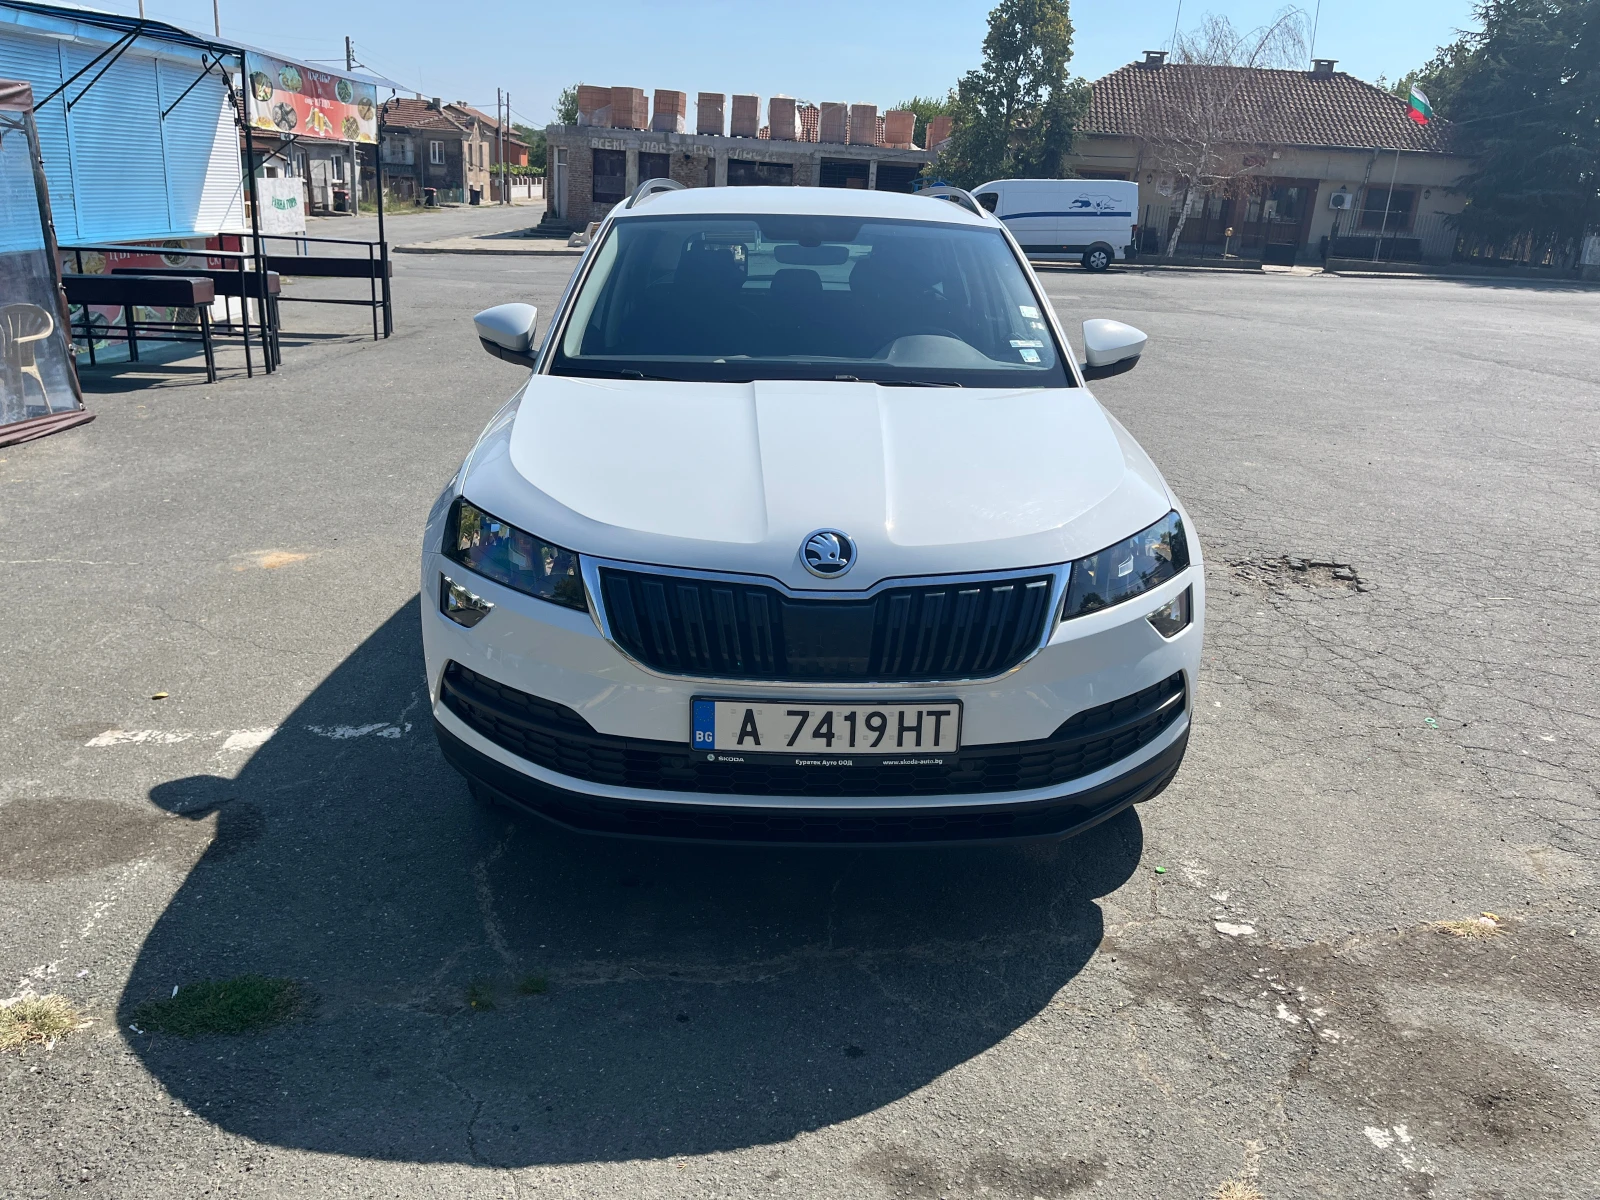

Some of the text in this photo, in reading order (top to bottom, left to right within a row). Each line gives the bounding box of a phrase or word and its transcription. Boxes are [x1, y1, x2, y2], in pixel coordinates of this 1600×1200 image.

[695, 730, 713, 743] BG
[736, 708, 952, 748] A 7419HT
